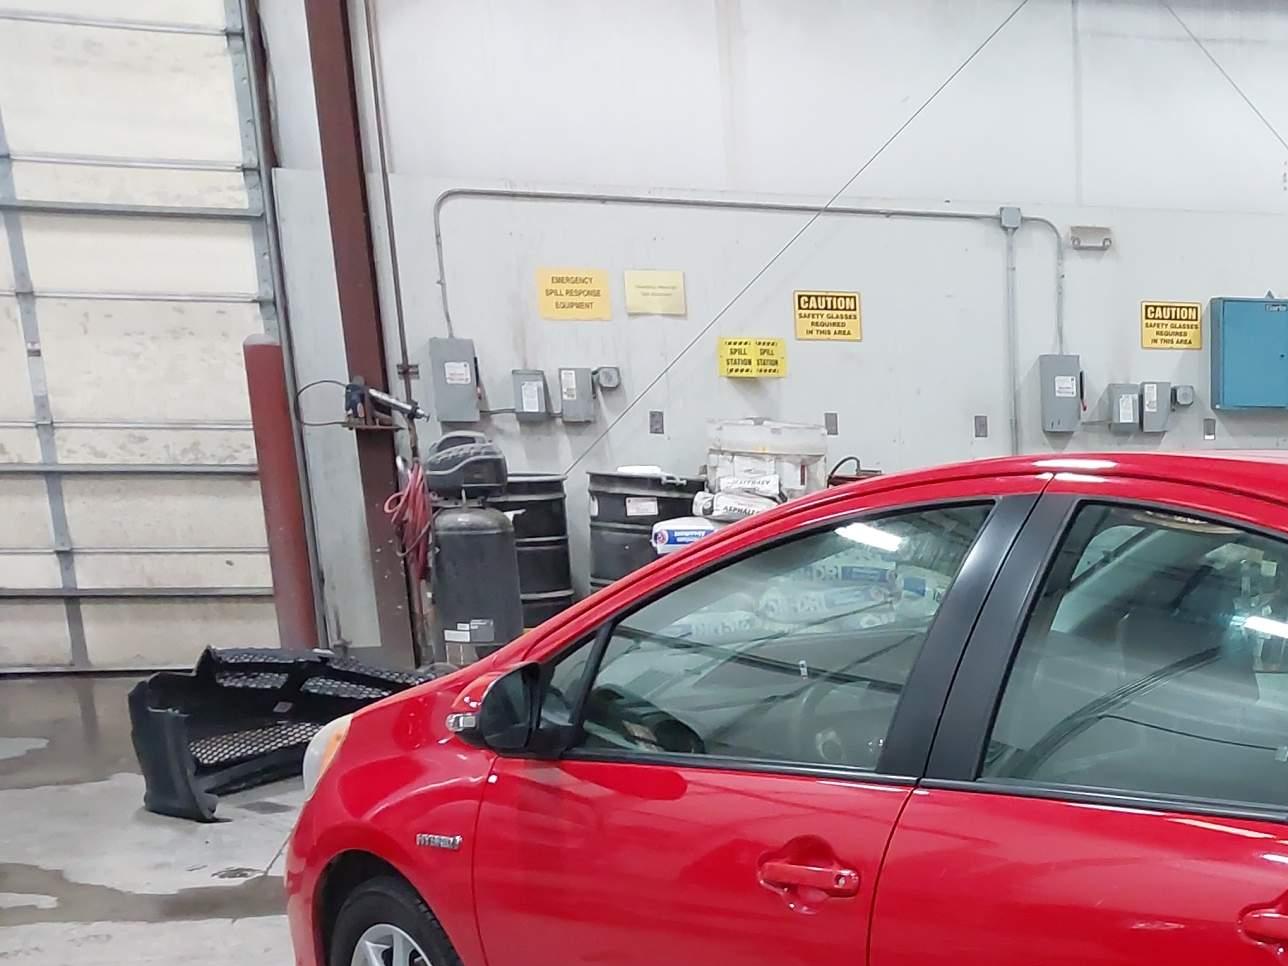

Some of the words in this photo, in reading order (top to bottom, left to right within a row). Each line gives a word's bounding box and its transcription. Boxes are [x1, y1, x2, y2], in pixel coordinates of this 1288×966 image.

[551, 276, 593, 284] EMERGENCY
[545, 289, 563, 297] SPILL
[565, 289, 601, 297] RESPONSE
[800, 295, 855, 310] CAUTION
[1147, 306, 1197, 320] CAUTION
[726, 358, 752, 366] STATION
